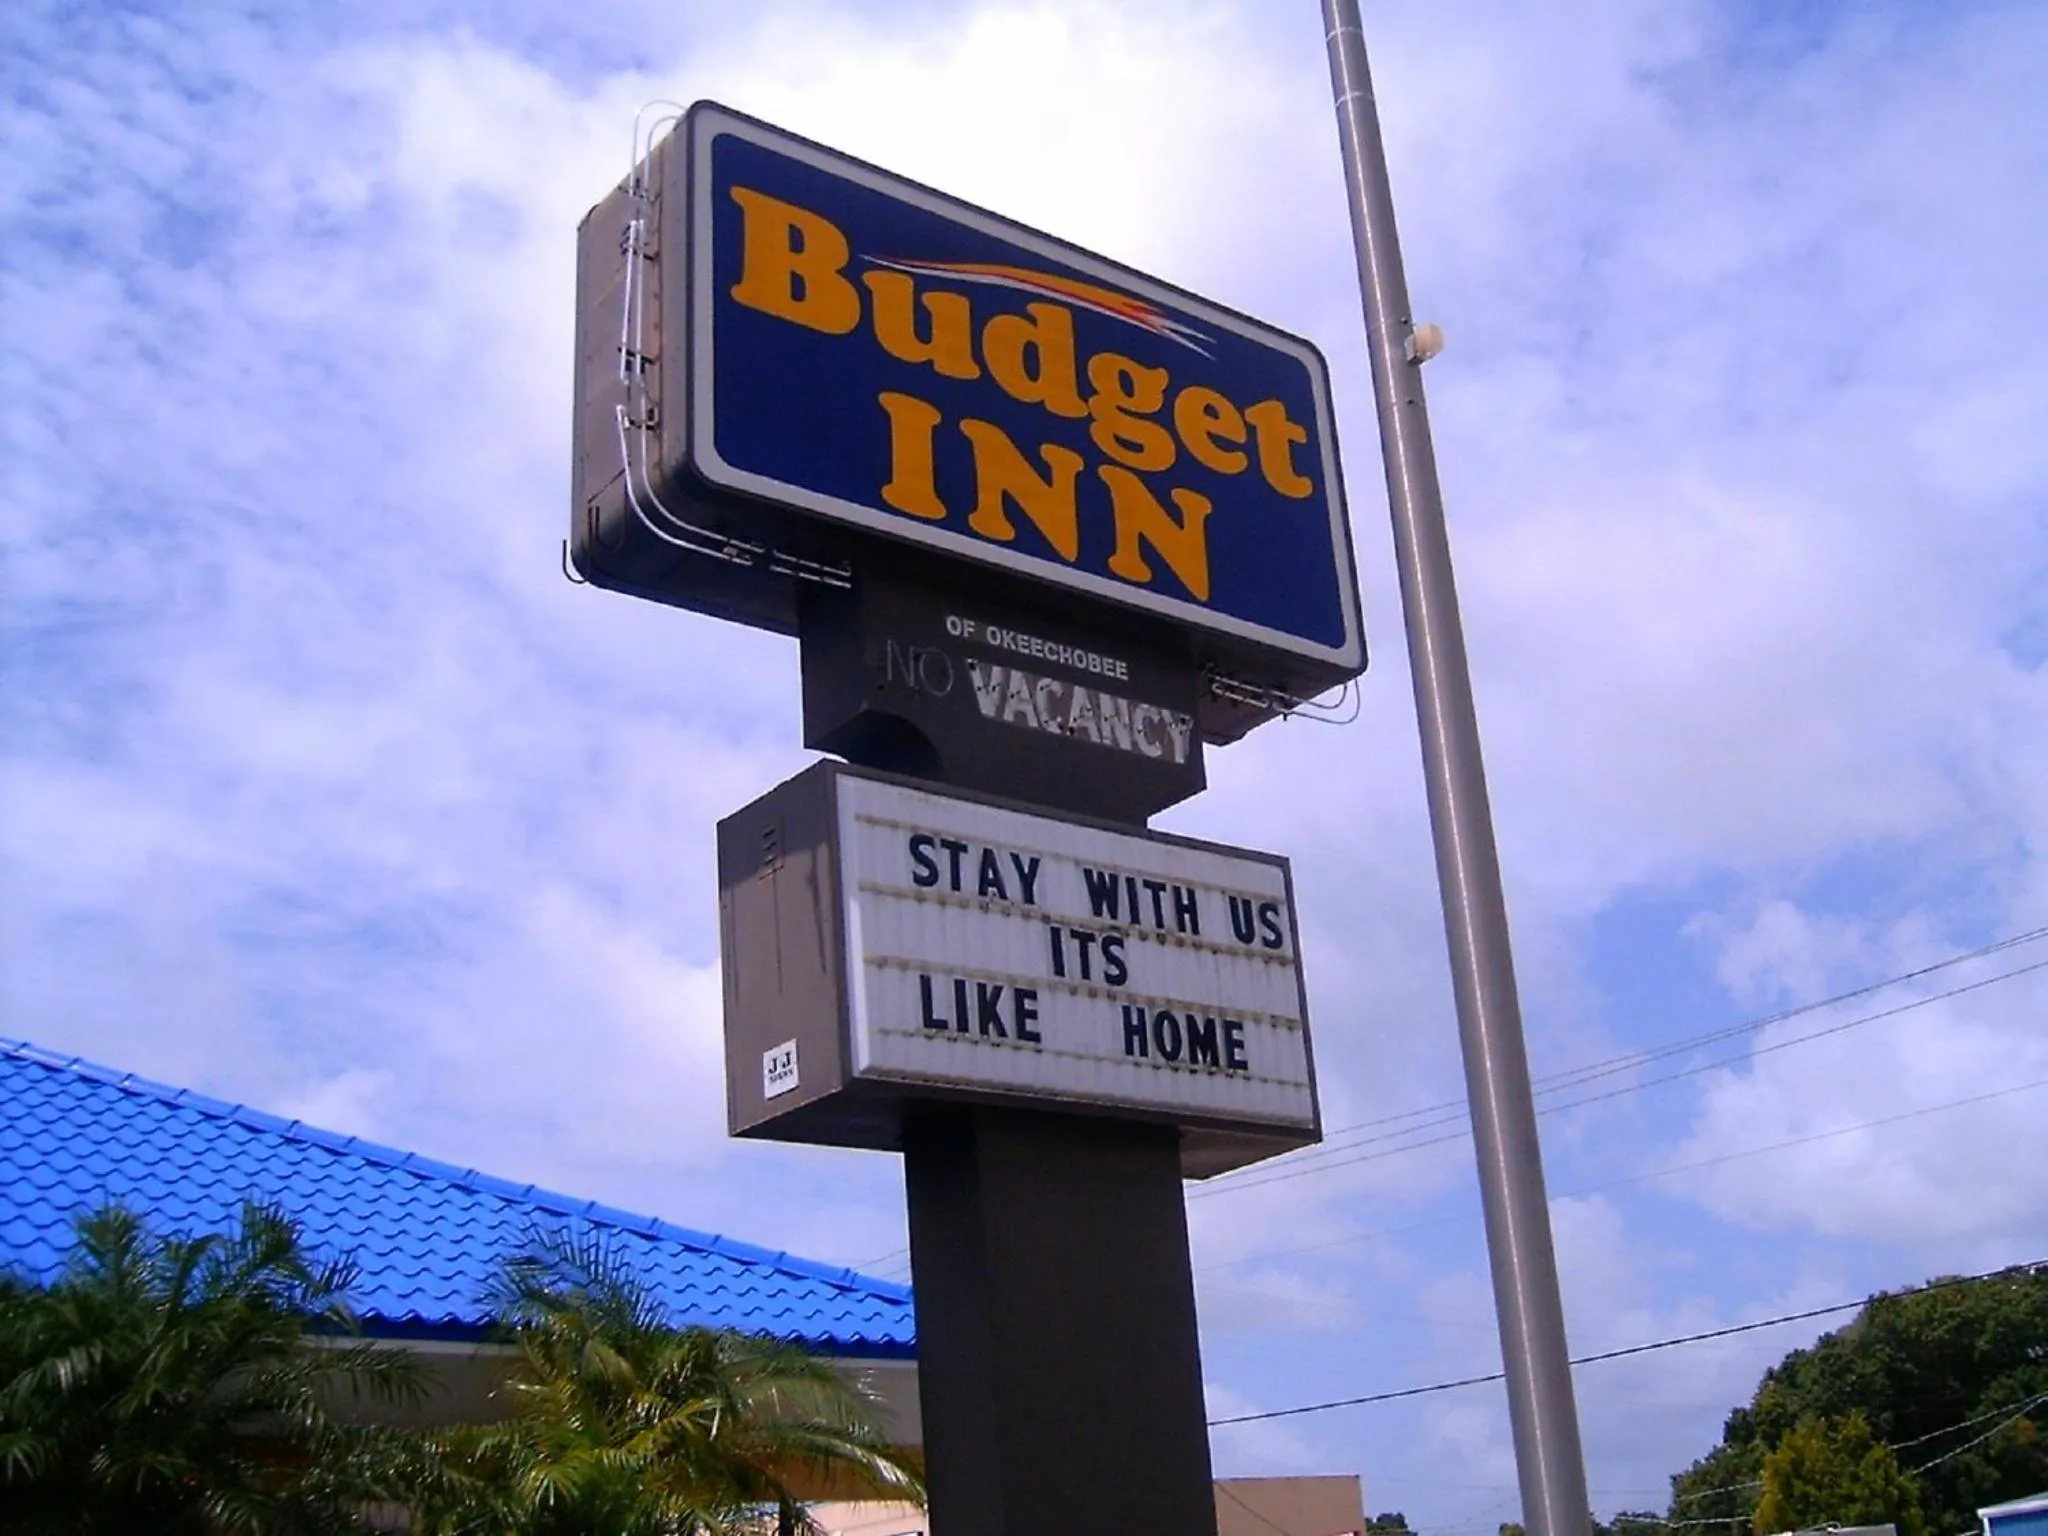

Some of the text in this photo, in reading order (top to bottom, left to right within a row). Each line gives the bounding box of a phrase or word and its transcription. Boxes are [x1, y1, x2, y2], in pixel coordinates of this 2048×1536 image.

[730, 185, 1313, 498] Budget
[878, 392, 1212, 601] INN
[886, 638, 1194, 764] NO VACANCY
[946, 615, 1129, 681] OF OKEECHOBEE
[909, 834, 1284, 950] STAY WITH US
[1049, 925, 1128, 987] ITS
[918, 973, 1249, 1071] LIKE HOME
